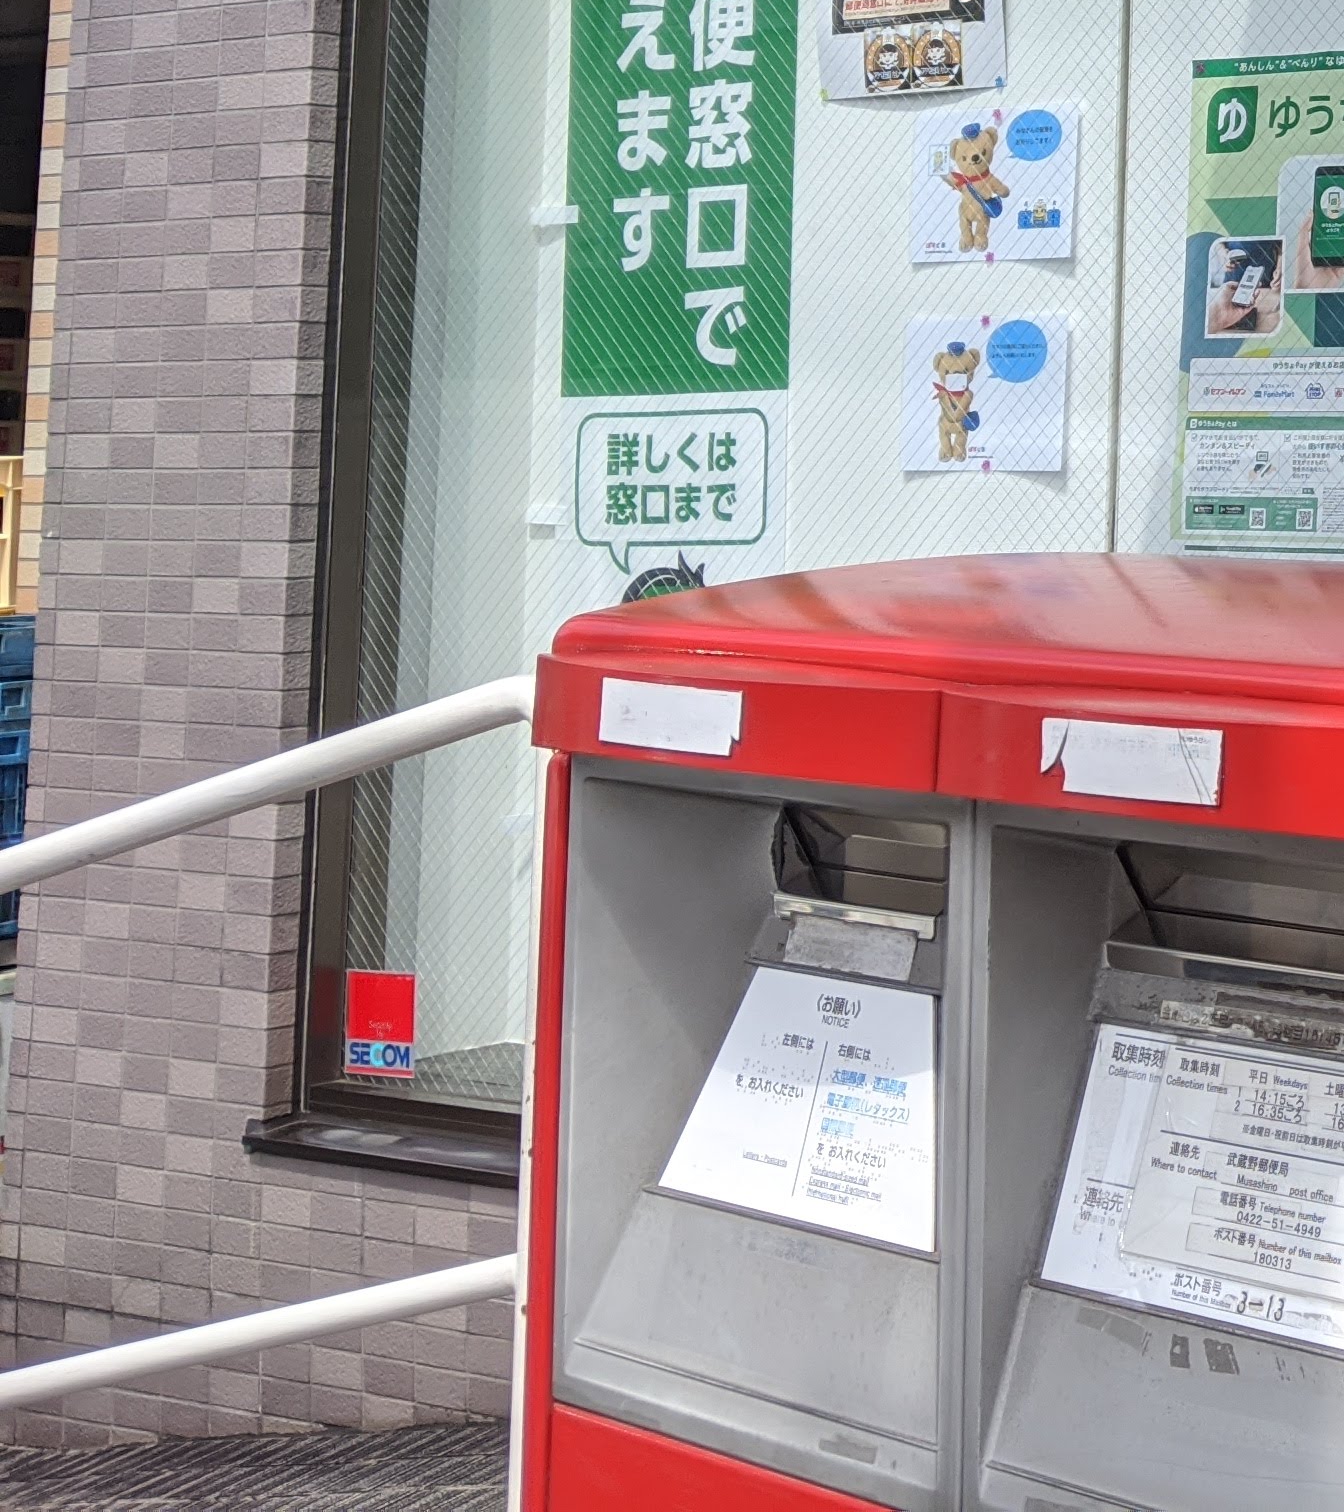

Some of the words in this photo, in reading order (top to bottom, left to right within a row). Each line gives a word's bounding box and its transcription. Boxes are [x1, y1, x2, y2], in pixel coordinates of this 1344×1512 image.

[606, 432, 737, 477] 詳しくは
[604, 482, 737, 526] 窓口まで
[821, 1015, 850, 1029] NOTICE
[782, 1032, 815, 1051] 左側には
[838, 1043, 872, 1061] 右側には
[349, 1041, 411, 1069] SECOM
[1111, 1041, 1166, 1069] 取集時刻
[1180, 1058, 1221, 1077] 取集時刻
[1166, 1075, 1205, 1090] Collection
[1249, 1069, 1269, 1085] 平日
[1273, 1075, 1308, 1091] Weekdays
[1254, 1089, 1305, 1110] 14:15ごろ
[1251, 1102, 1303, 1124] 16:35ごろ
[1169, 1141, 1201, 1160] 連絡先
[1151, 1158, 1175, 1172] Where
[1187, 1167, 1218, 1181] contact
[1226, 1152, 1289, 1178] 武蔵野郵便局
[1083, 1186, 1125, 1214] 連絡先
[1220, 1190, 1257, 1212] 電話番号
[1288, 1187, 1308, 1201] post
[1310, 1189, 1334, 1204] office
[1236, 1210, 1322, 1239] 0422-51-4949
[1213, 1227, 1256, 1249] ポスト番号
[1252, 1250, 1292, 1271] 180313
